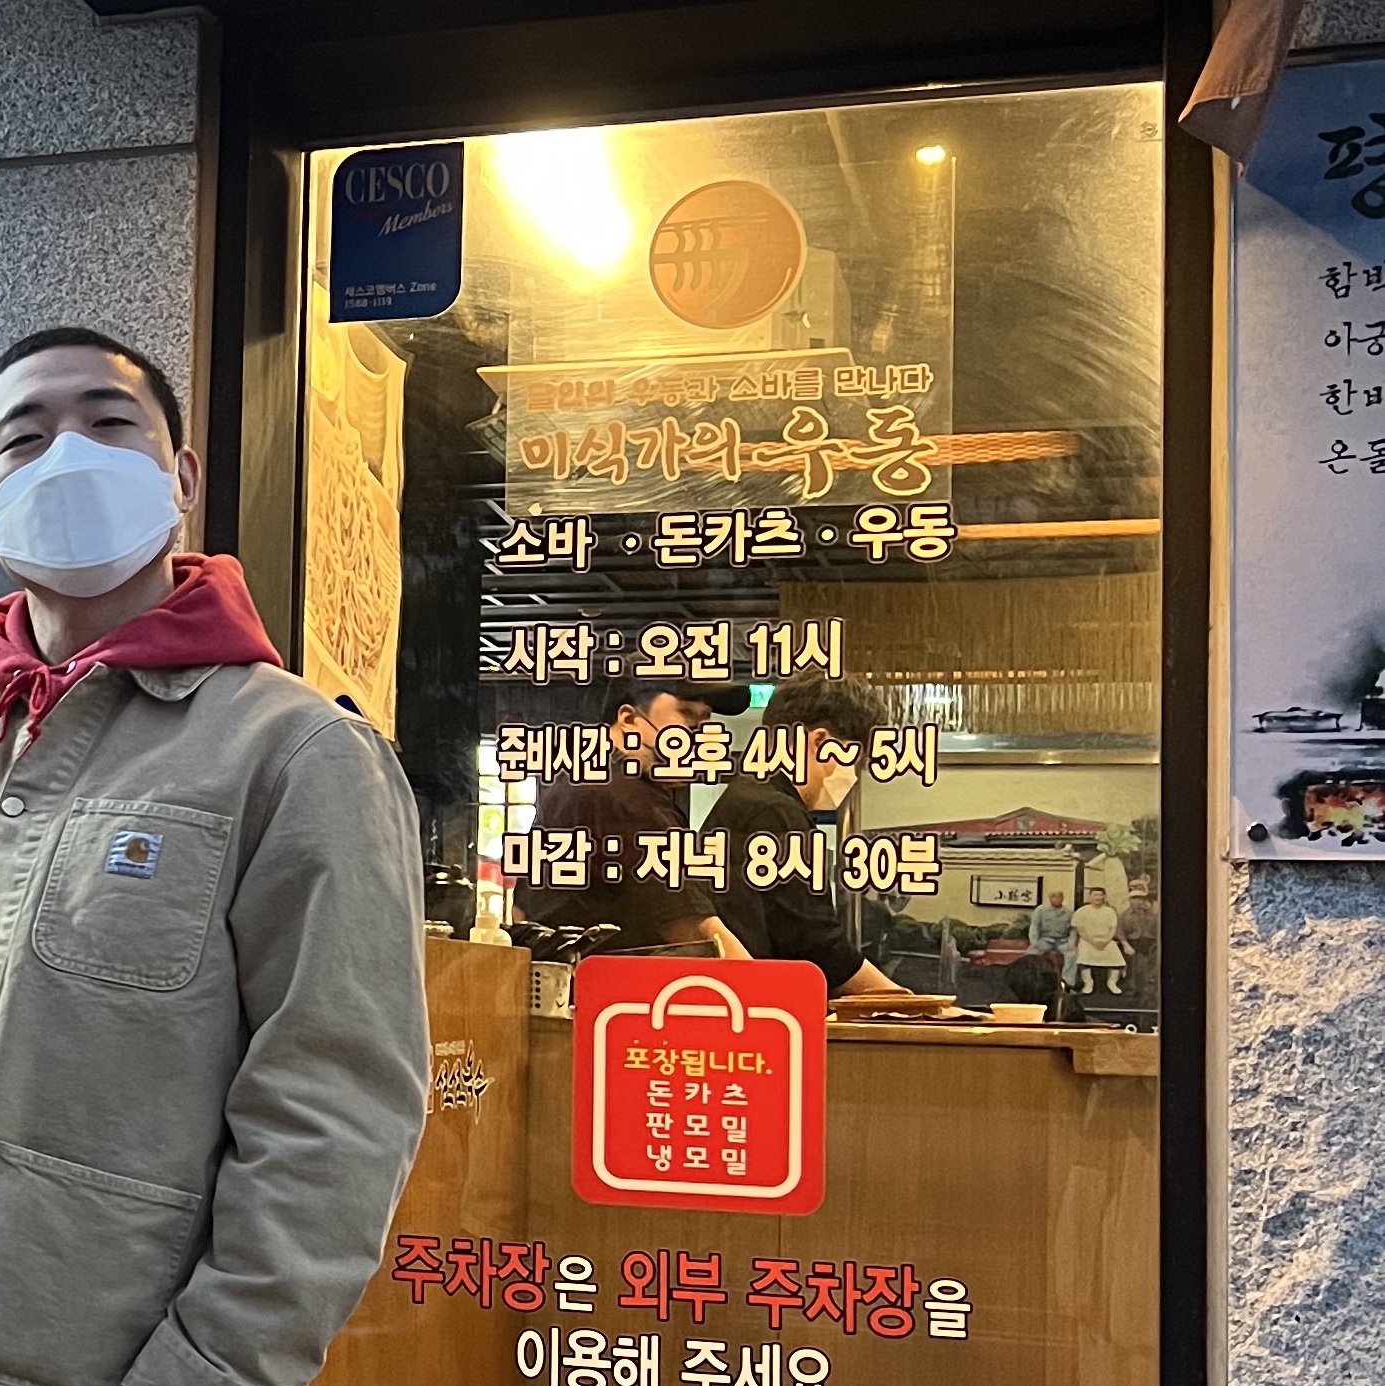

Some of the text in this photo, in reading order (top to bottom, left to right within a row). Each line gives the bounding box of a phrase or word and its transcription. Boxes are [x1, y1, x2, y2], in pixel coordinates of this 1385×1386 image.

[345, 161, 450, 205] CESCO
[378, 201, 454, 238] Members
[730, 367, 822, 401] 소바를
[833, 363, 935, 398] 만나다
[519, 405, 939, 500] 미식가의 우동
[498, 514, 593, 571] 소바
[654, 508, 802, 566] 돈카츠
[852, 503, 957, 561] 우동
[503, 623, 596, 682] 시작
[634, 621, 732, 679] 오전
[747, 618, 844, 678] 11시
[497, 726, 612, 784] 준비시간
[652, 724, 733, 780] 오후
[742, 725, 806, 784] 4시
[870, 724, 938, 784] 5시
[503, 829, 593, 887] 마감
[636, 831, 726, 888] 저녁
[745, 831, 824, 889] 8시
[843, 835, 941, 892] 30분
[623, 1046, 773, 1077] 포장됩니다.
[392, 1234, 972, 1339] 주차장은 외부 주차장을
